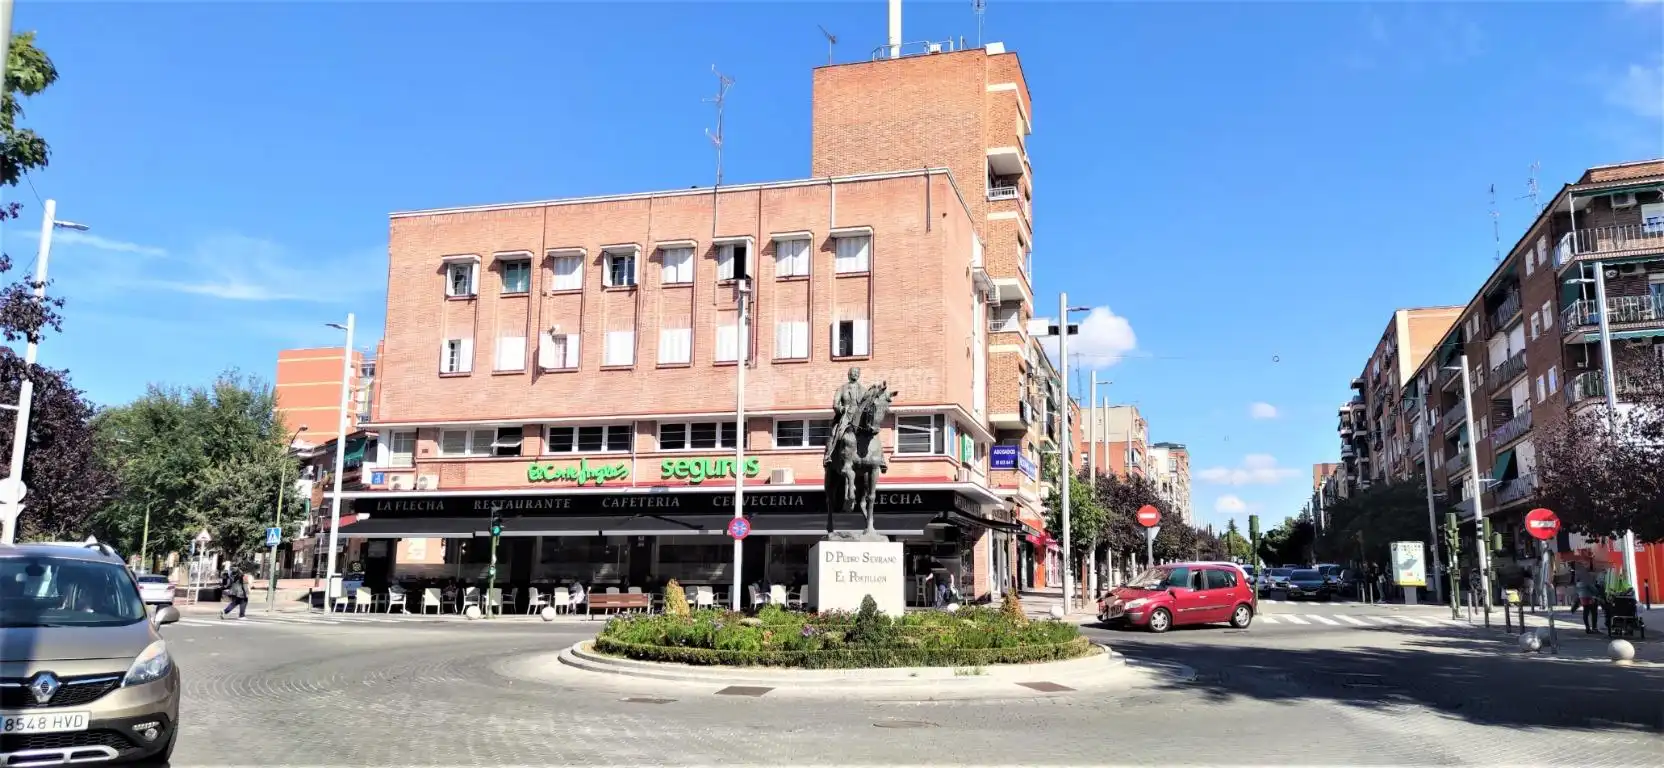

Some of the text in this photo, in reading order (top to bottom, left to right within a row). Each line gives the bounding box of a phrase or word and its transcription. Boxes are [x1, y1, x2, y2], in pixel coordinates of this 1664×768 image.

[660, 456, 760, 485] seguros
[474, 498, 572, 511] RESTAURANTE
[712, 494, 805, 507] CEVECERIA
[873, 493, 924, 505] ECHA
[377, 500, 445, 512] LA FLECHA
[5, 714, 83, 732] 8548 HVD
